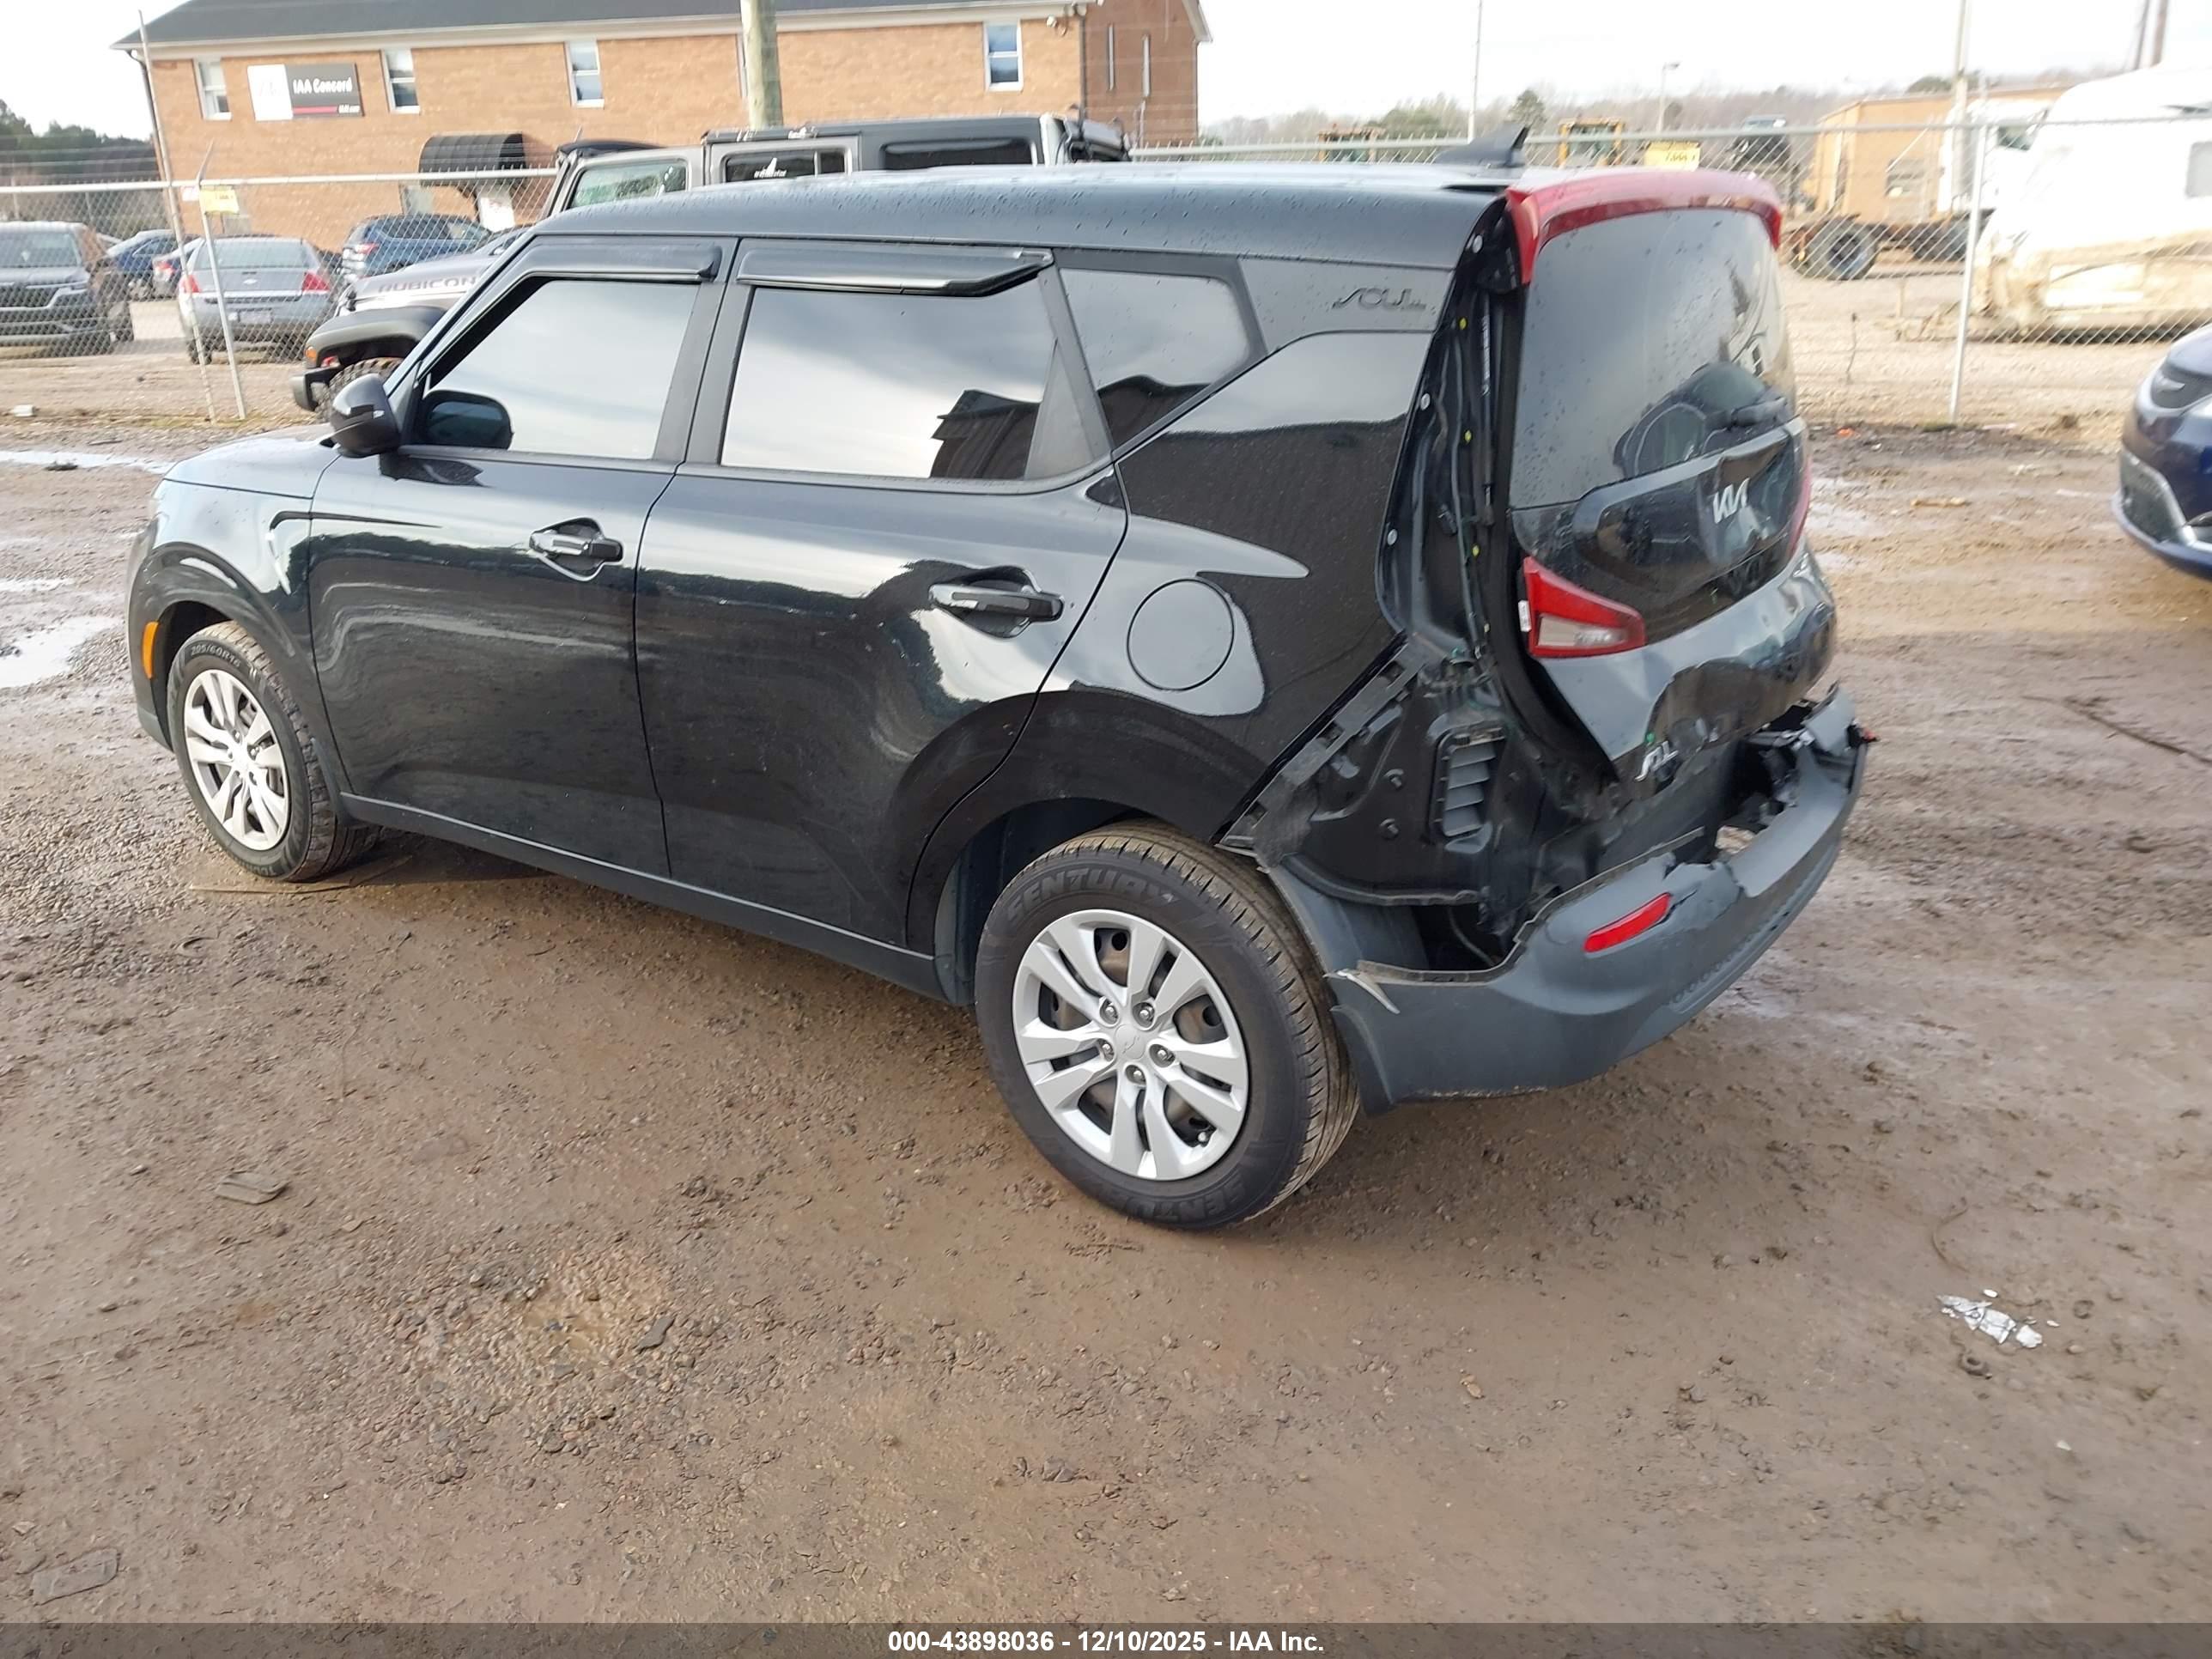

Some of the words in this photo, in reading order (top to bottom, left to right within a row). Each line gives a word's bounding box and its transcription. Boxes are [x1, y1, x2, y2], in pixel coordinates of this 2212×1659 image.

[293, 78, 313, 94] IAA
[313, 76, 353, 94] Concord
[378, 276, 477, 294] RUBICON
[1006, 866, 1171, 923] SENTURY
